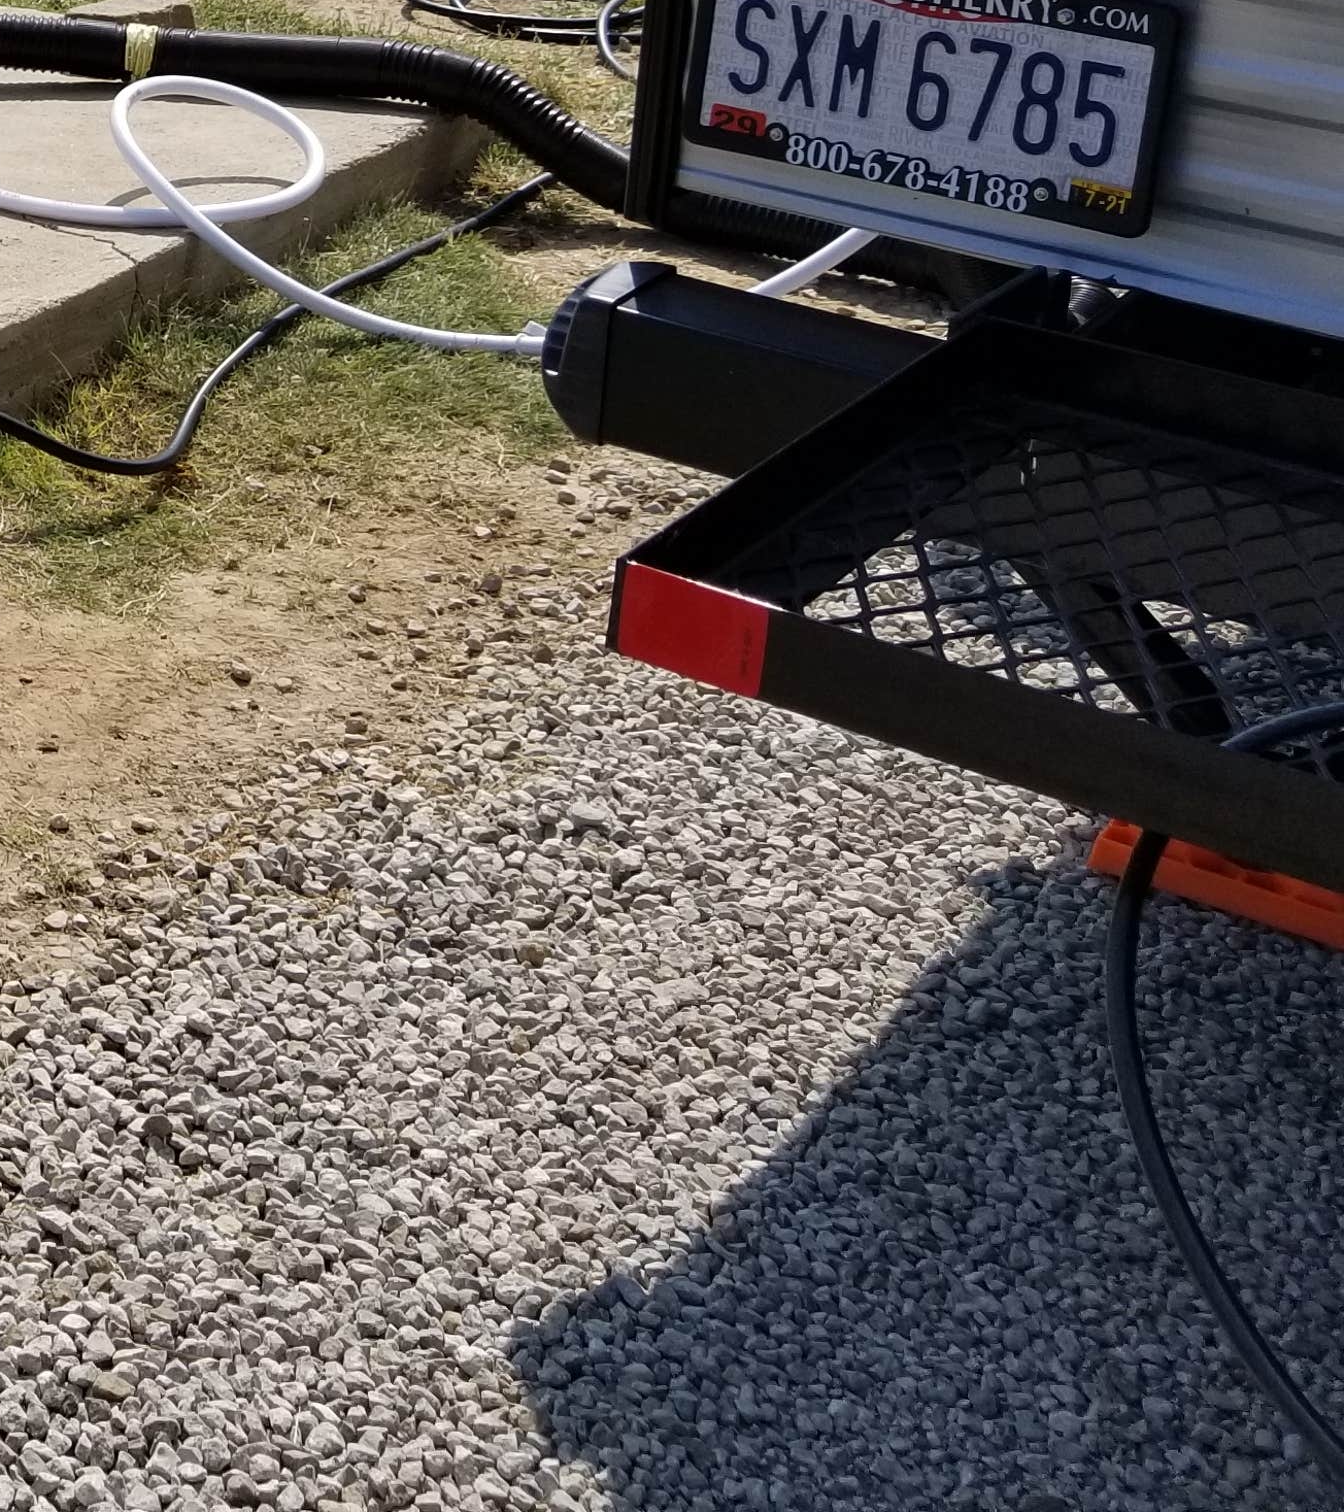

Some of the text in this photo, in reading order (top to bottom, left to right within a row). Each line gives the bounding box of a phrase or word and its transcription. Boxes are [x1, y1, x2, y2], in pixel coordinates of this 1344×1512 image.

[956, 22, 1045, 47] AVIATION
[905, 30, 1127, 168] 6785
[784, 134, 1030, 213] 800-678-4188
